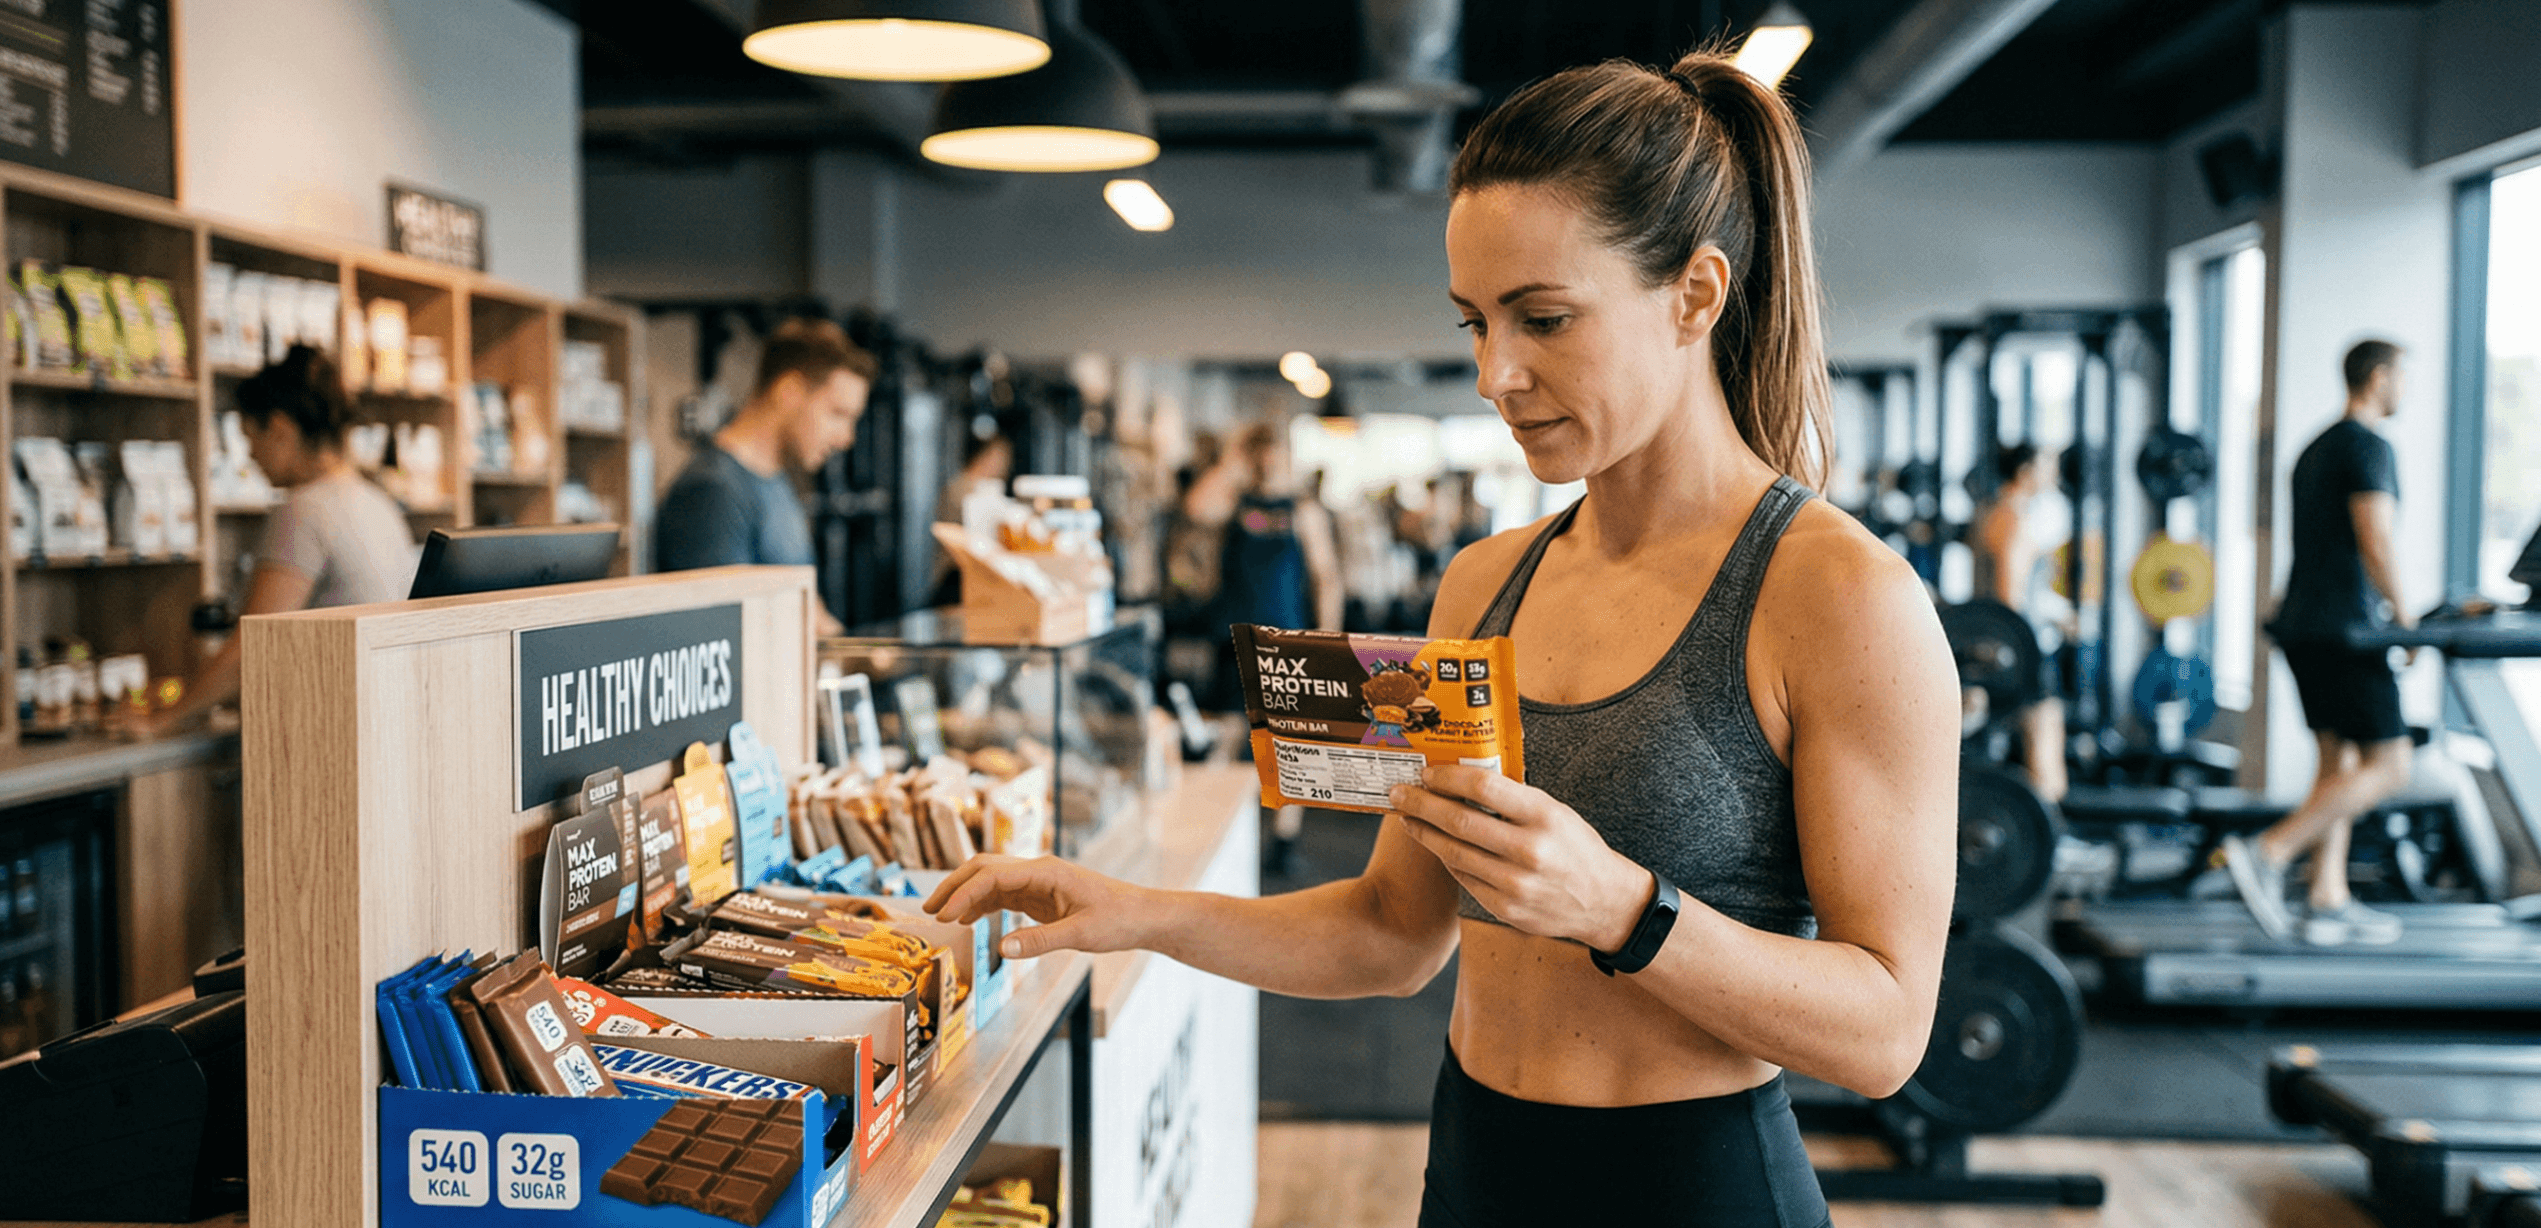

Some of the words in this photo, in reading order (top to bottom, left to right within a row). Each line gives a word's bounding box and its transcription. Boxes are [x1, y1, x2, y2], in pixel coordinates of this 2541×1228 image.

[1257, 655, 1308, 677] MAX
[542, 656, 644, 757] HEALTHY
[649, 638, 732, 727] CHOICES
[1260, 674, 1349, 698] PROTEIN
[1262, 692, 1299, 712] BAR
[1310, 787, 1332, 799] 210
[567, 837, 596, 869] MAX
[568, 885, 590, 912] BAR
[536, 1005, 560, 1039] 540
[421, 1139, 477, 1174] 540
[511, 1143, 566, 1181] 32g
[428, 1178, 471, 1197] KCAL
[510, 1182, 567, 1200] SUGAR
